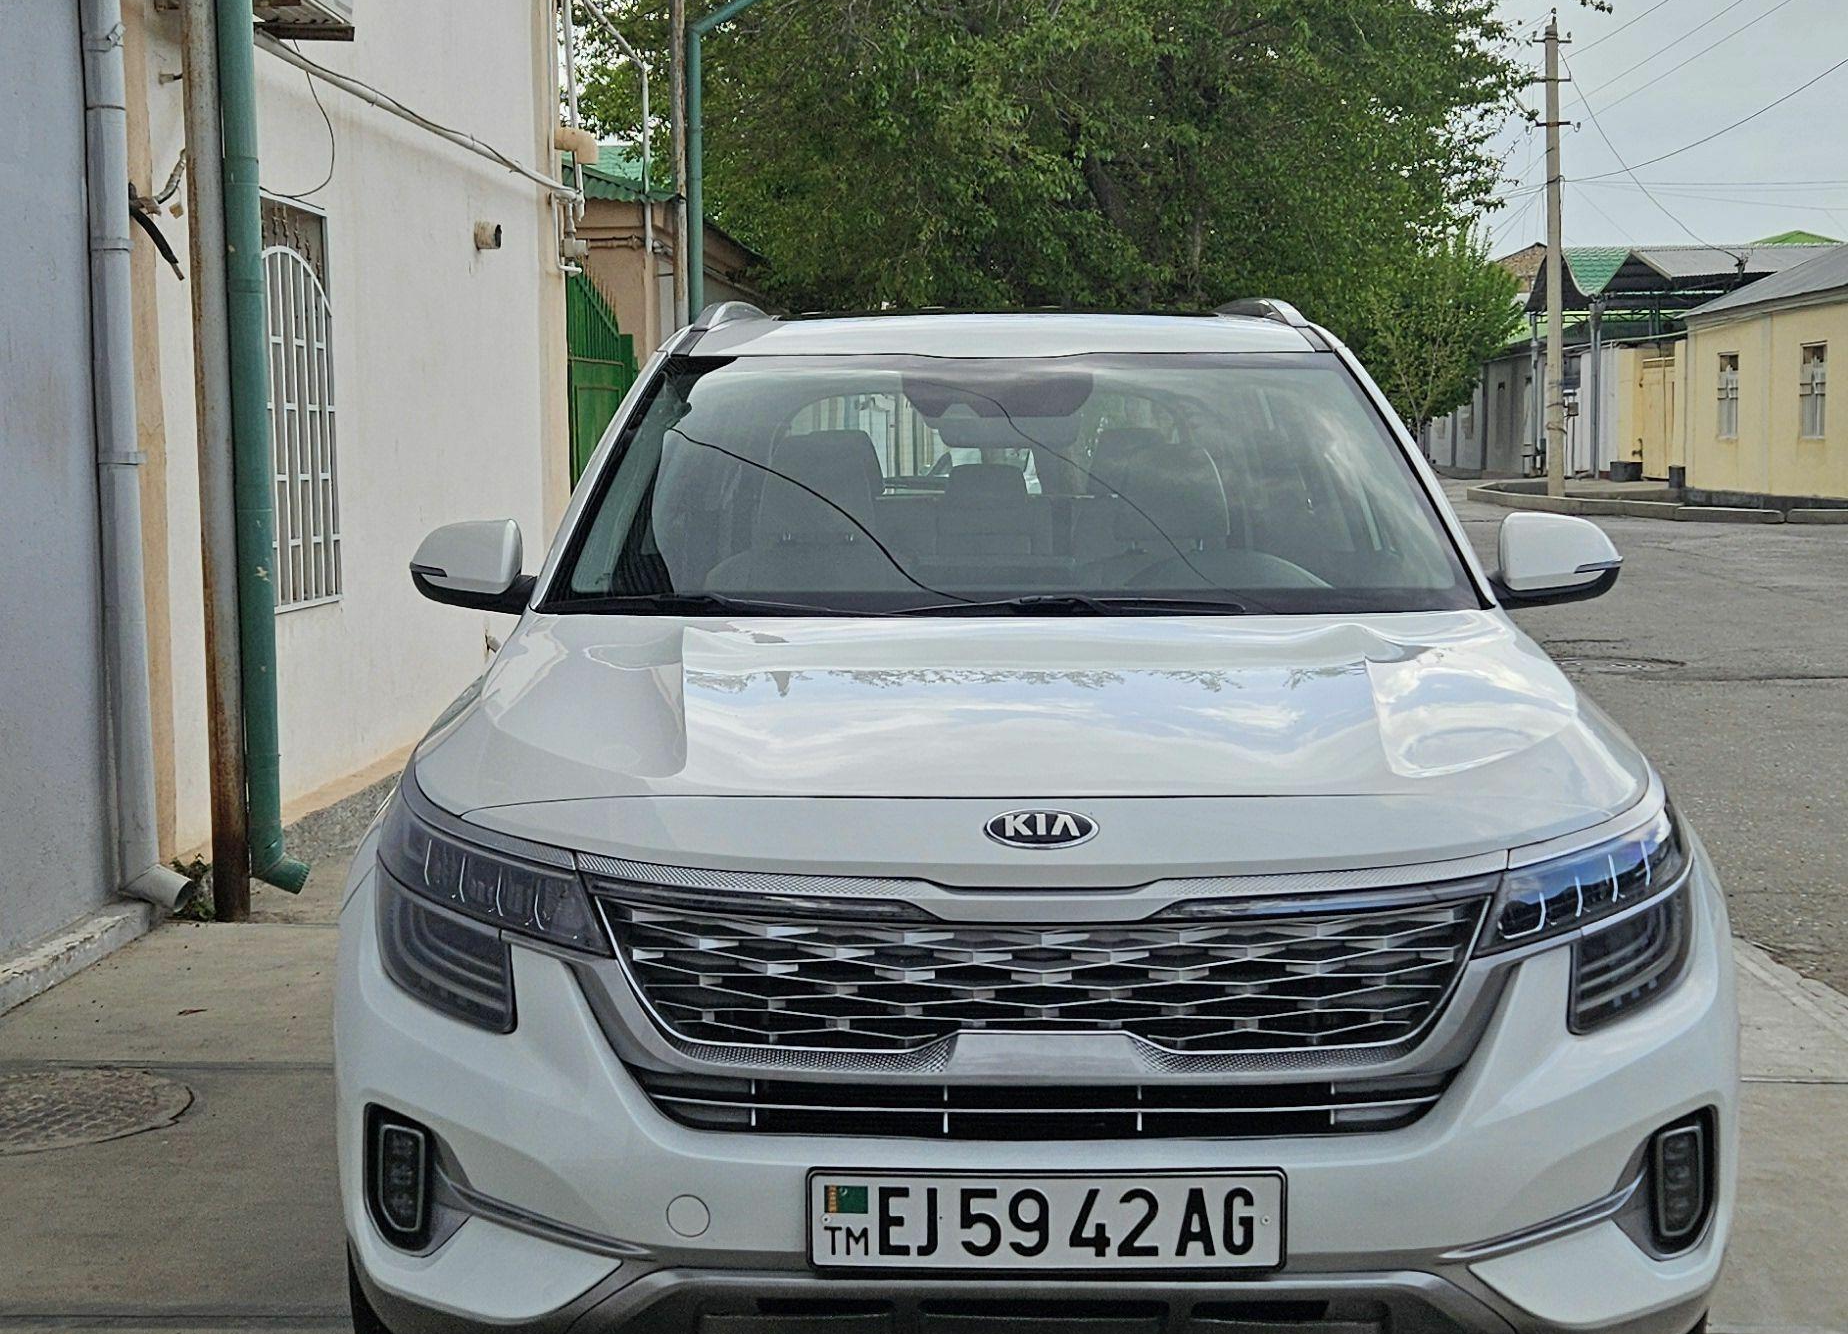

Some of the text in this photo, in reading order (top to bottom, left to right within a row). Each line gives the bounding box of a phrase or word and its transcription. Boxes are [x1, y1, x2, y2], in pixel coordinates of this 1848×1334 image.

[1003, 813, 1080, 837] KIA
[878, 1186, 1254, 1257] EJ 59 42 AG
[824, 1226, 868, 1255] TM
